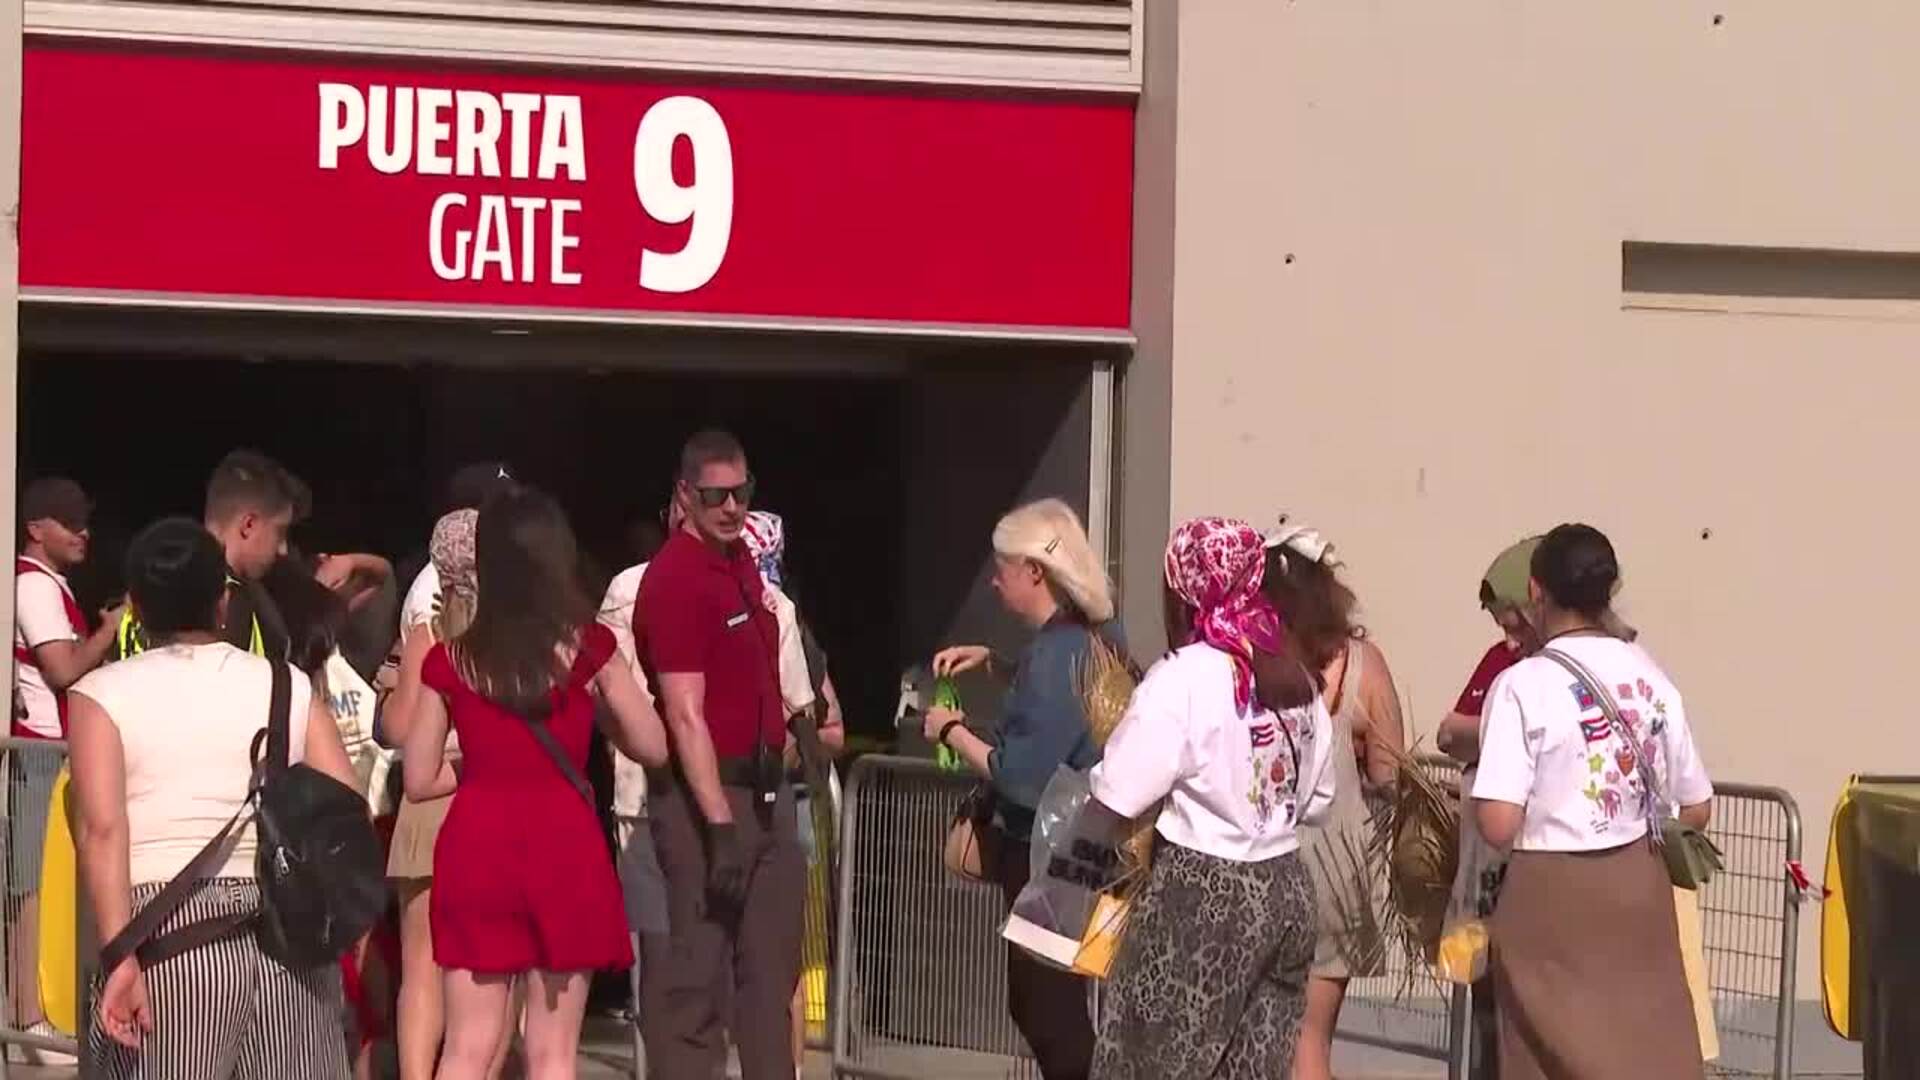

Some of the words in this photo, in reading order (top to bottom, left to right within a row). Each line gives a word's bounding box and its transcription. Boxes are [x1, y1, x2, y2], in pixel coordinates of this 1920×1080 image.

[318, 83, 587, 181] PUERTA
[429, 193, 582, 285] GATE
[633, 95, 734, 293] 9
